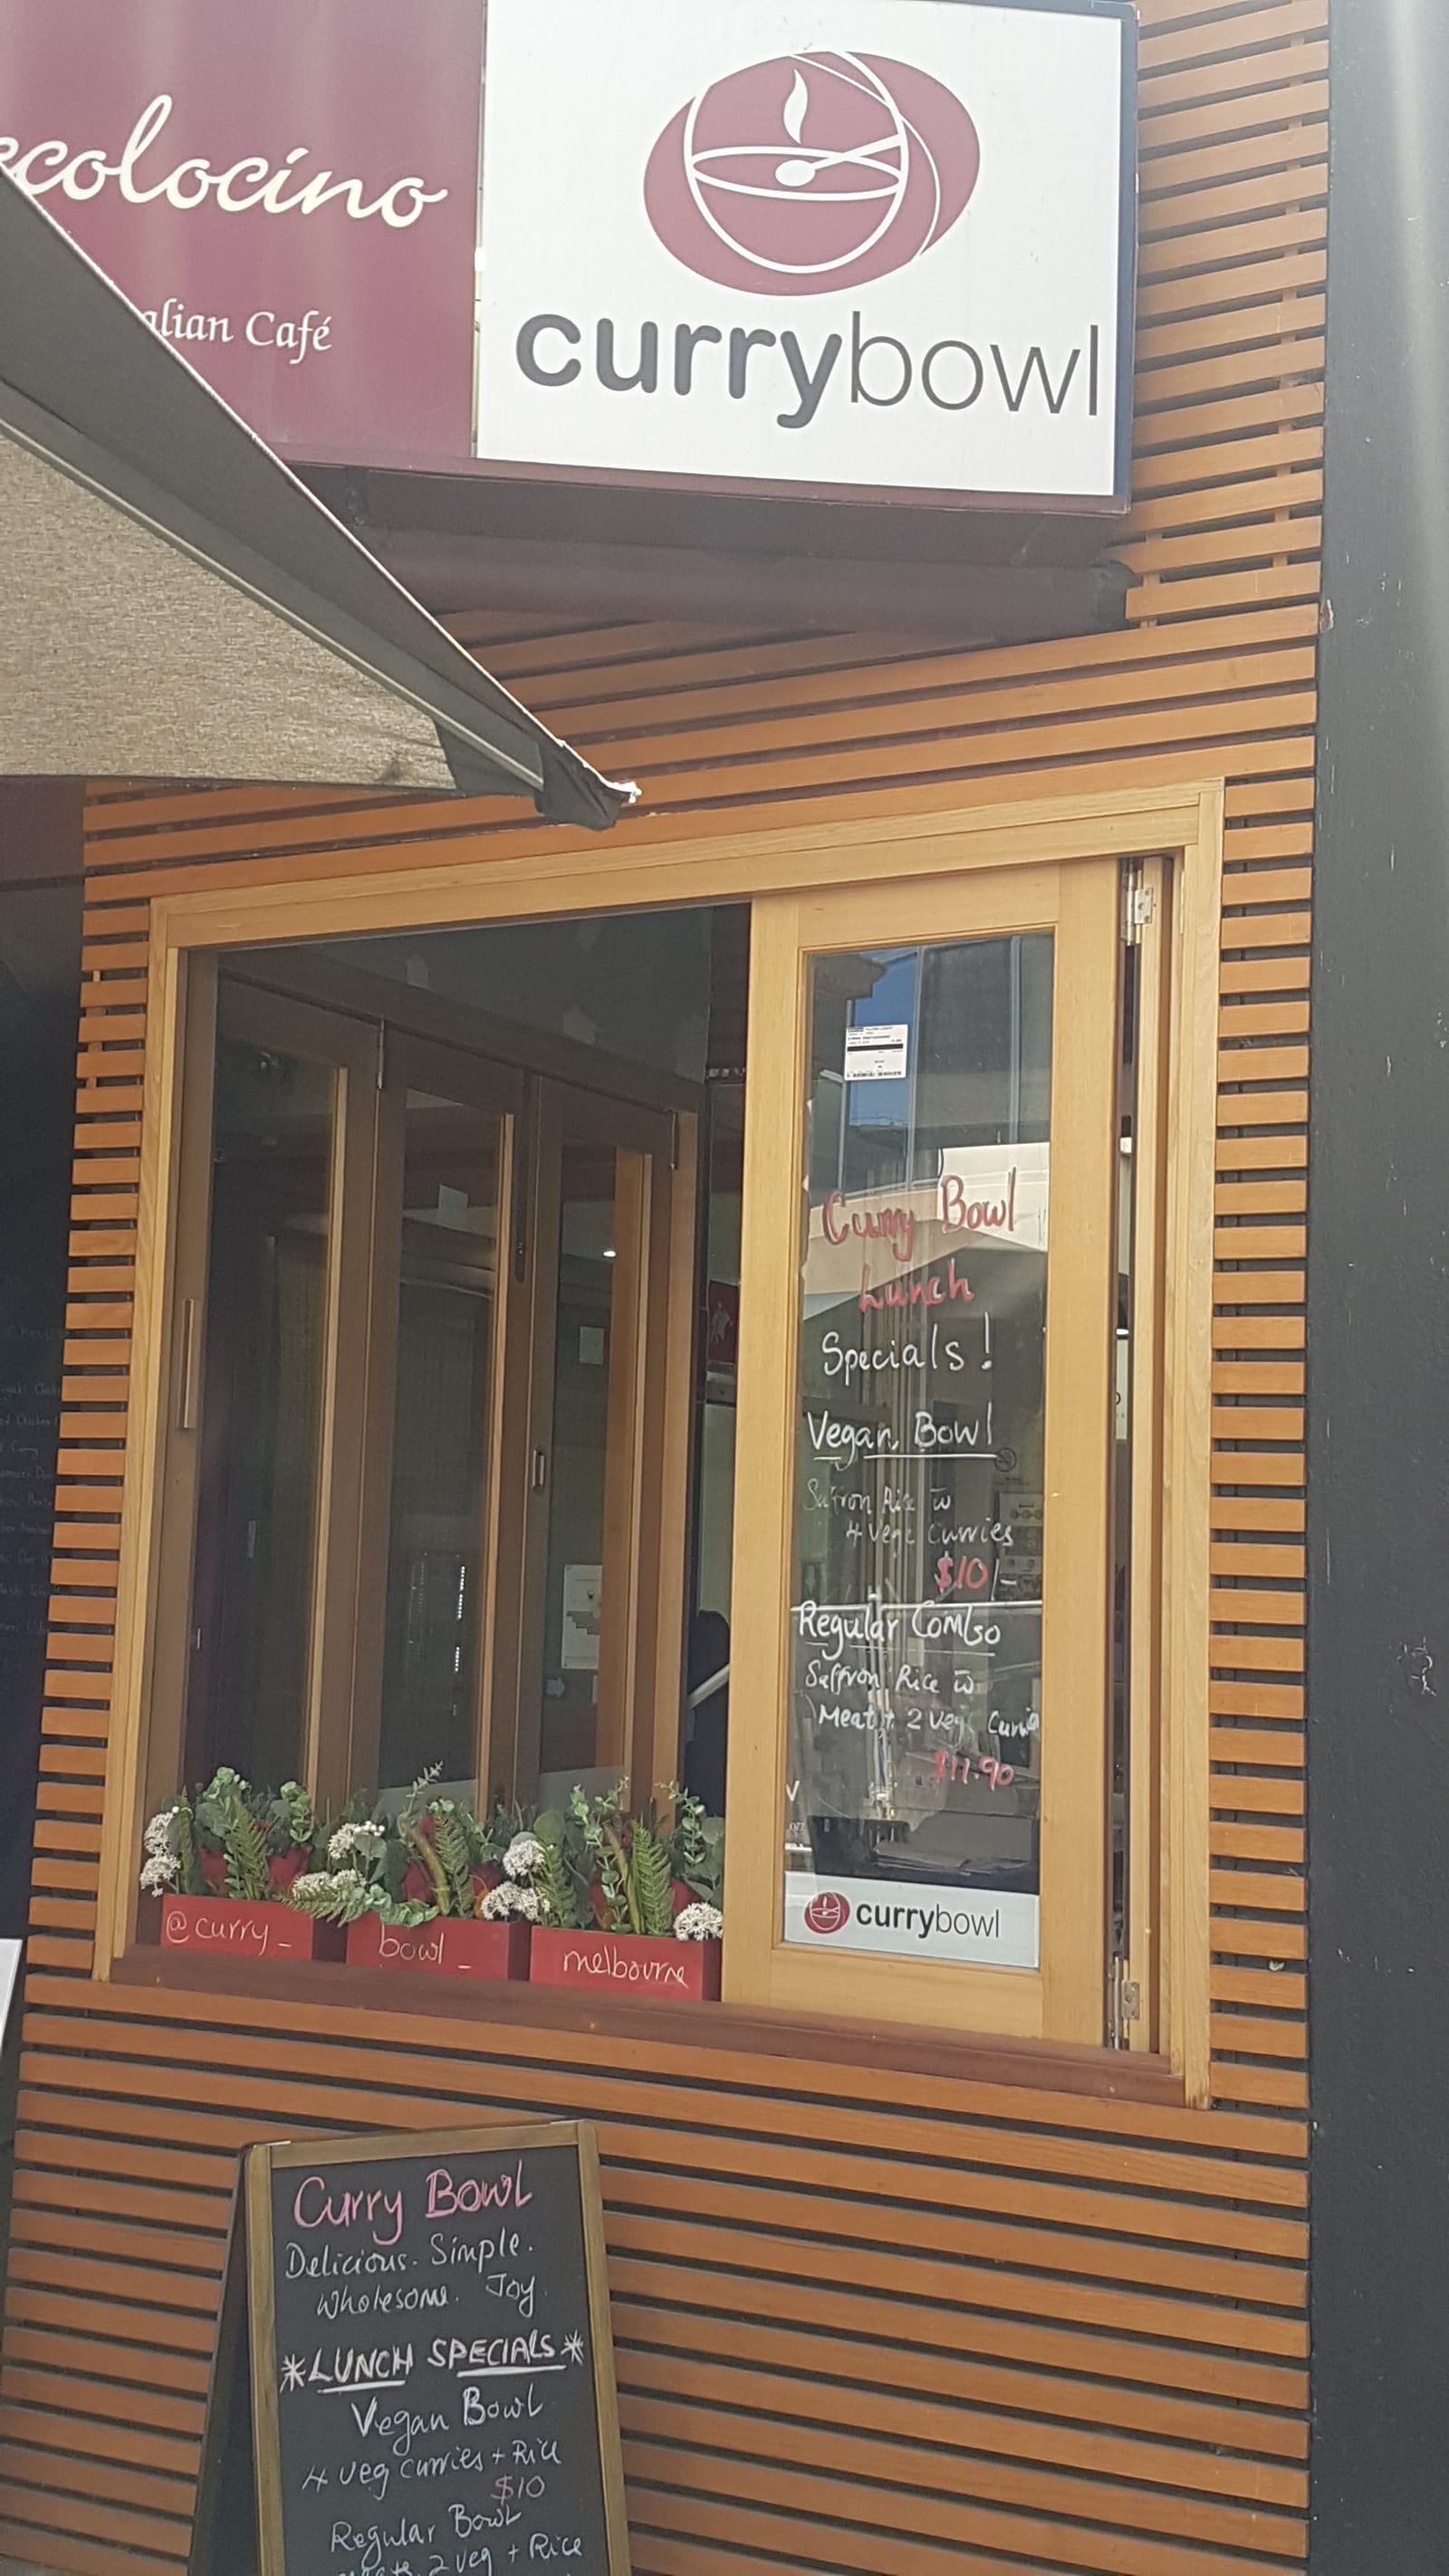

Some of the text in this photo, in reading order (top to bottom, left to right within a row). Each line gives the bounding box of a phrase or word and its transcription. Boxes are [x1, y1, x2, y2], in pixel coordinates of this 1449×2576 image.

[246, 311, 331, 364] Café
[515, 310, 1099, 428] currybowl
[823, 1167, 1016, 1262] Curry Bowl
[859, 1258, 974, 1312] Lunch
[807, 1401, 993, 1471] Vegan Bowl
[799, 1600, 898, 1660] Regular
[805, 1659, 880, 1694] Saffron
[896, 1665, 940, 1694] Rice
[907, 1708, 922, 1729] 2
[856, 1903, 1000, 1938] currybowl
[293, 2159, 533, 2245] Curry Bowl
[351, 2384, 543, 2456] Vegan Bowl
[302, 2465, 328, 2494] 4
[493, 2449, 504, 2464] +
[512, 2439, 561, 2465] Rice
[490, 2475, 545, 2505] $10
[331, 2504, 523, 2569] Regular Bowl
[508, 2547, 519, 2562] +
[529, 2533, 582, 2560] Rice
